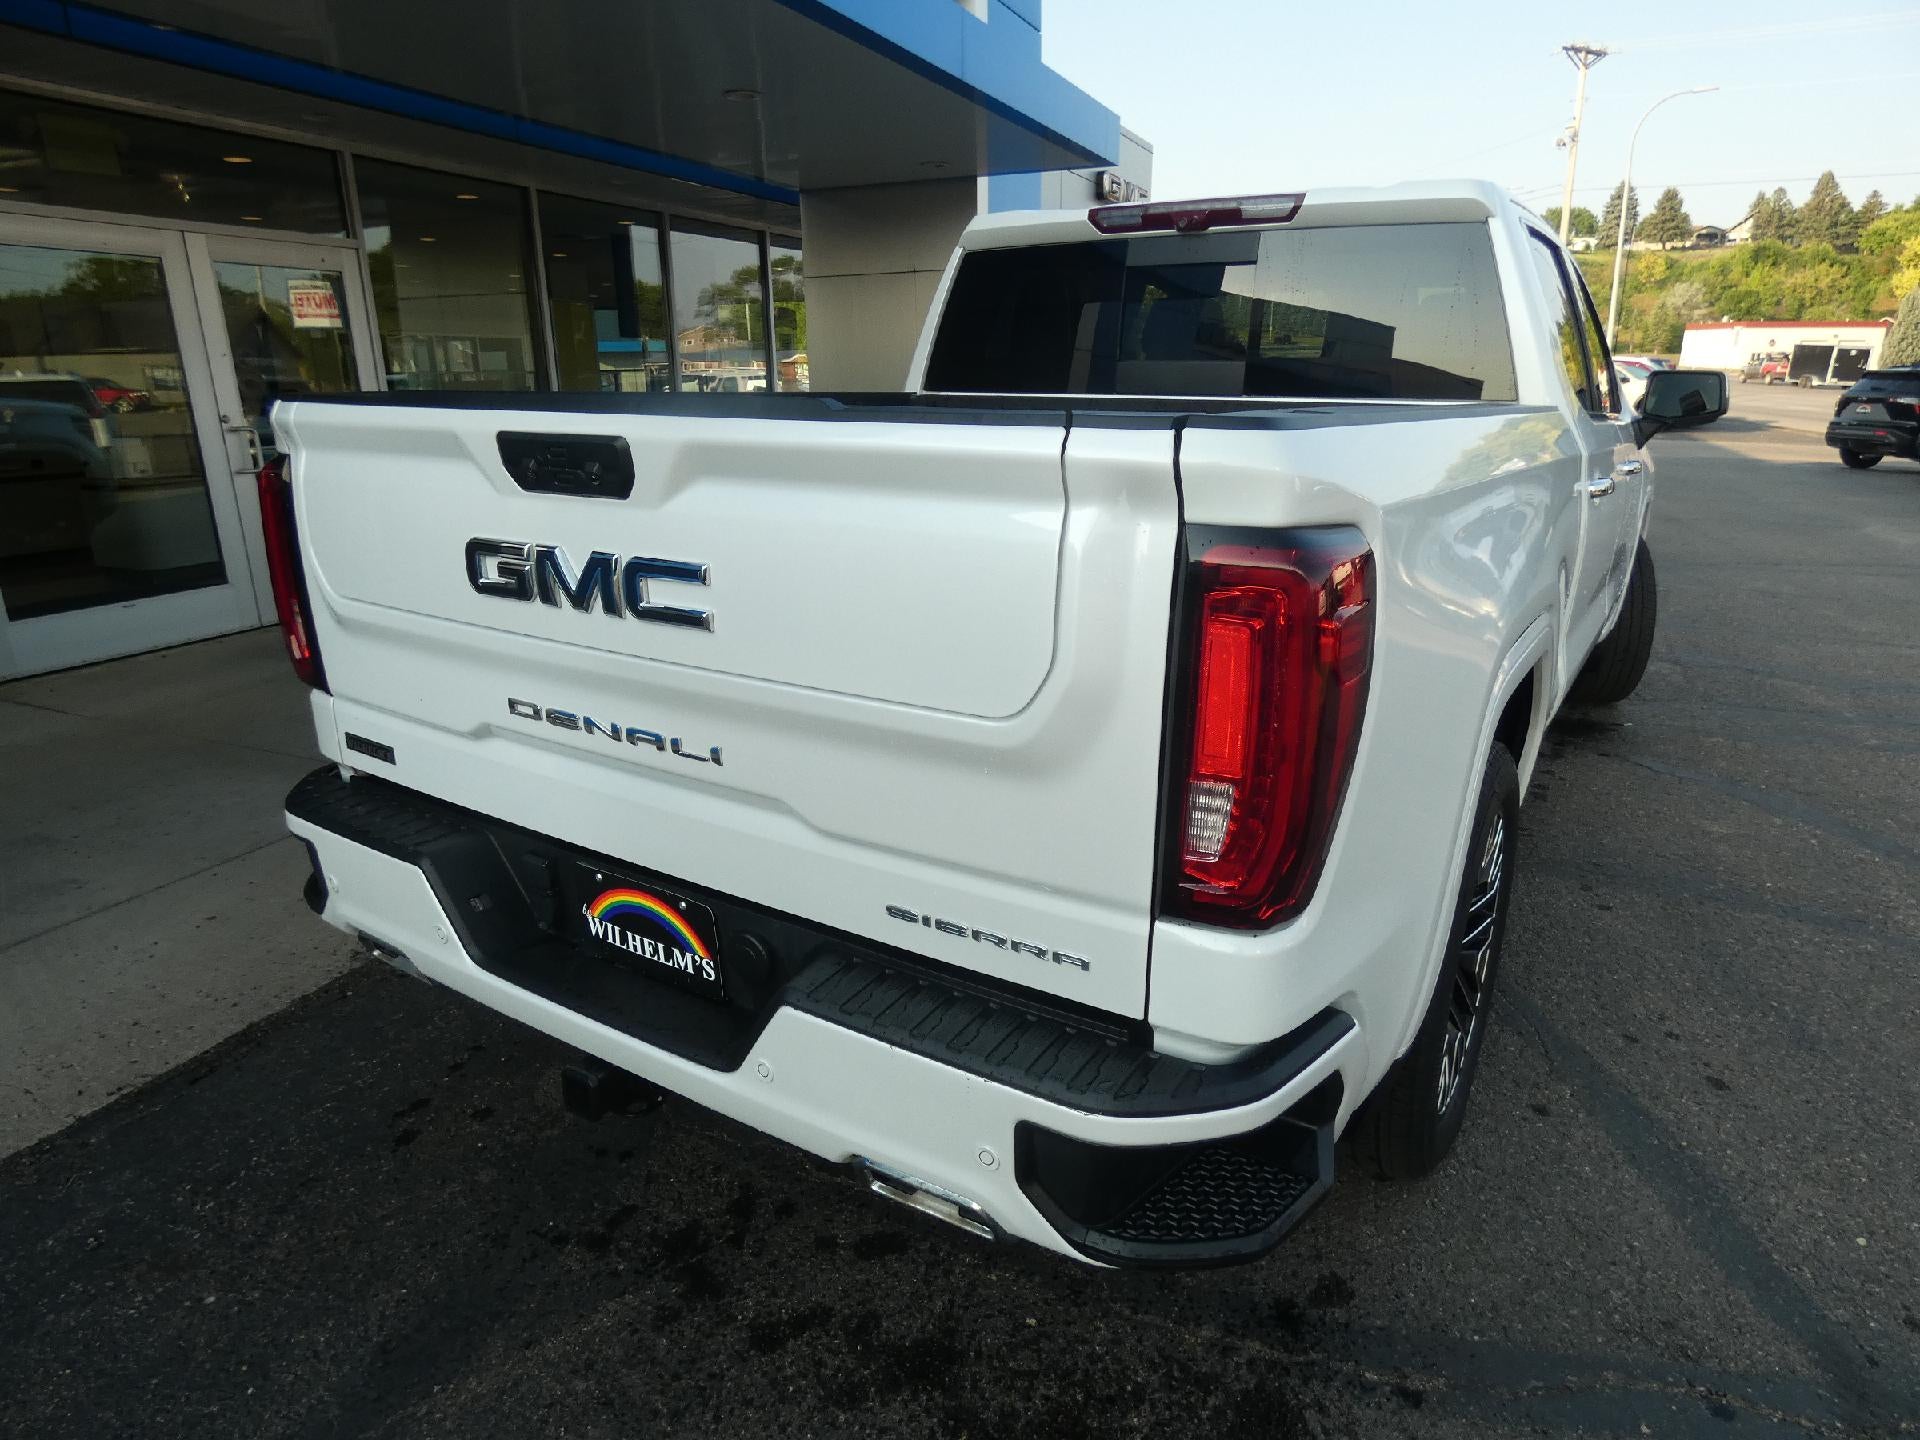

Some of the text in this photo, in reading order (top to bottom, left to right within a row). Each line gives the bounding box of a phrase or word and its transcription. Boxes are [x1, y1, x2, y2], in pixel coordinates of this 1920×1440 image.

[465, 536, 714, 633] GMC
[507, 697, 723, 767] DENALI
[586, 914, 716, 981] WILHELM'S
[886, 903, 1090, 971] SIERRA
